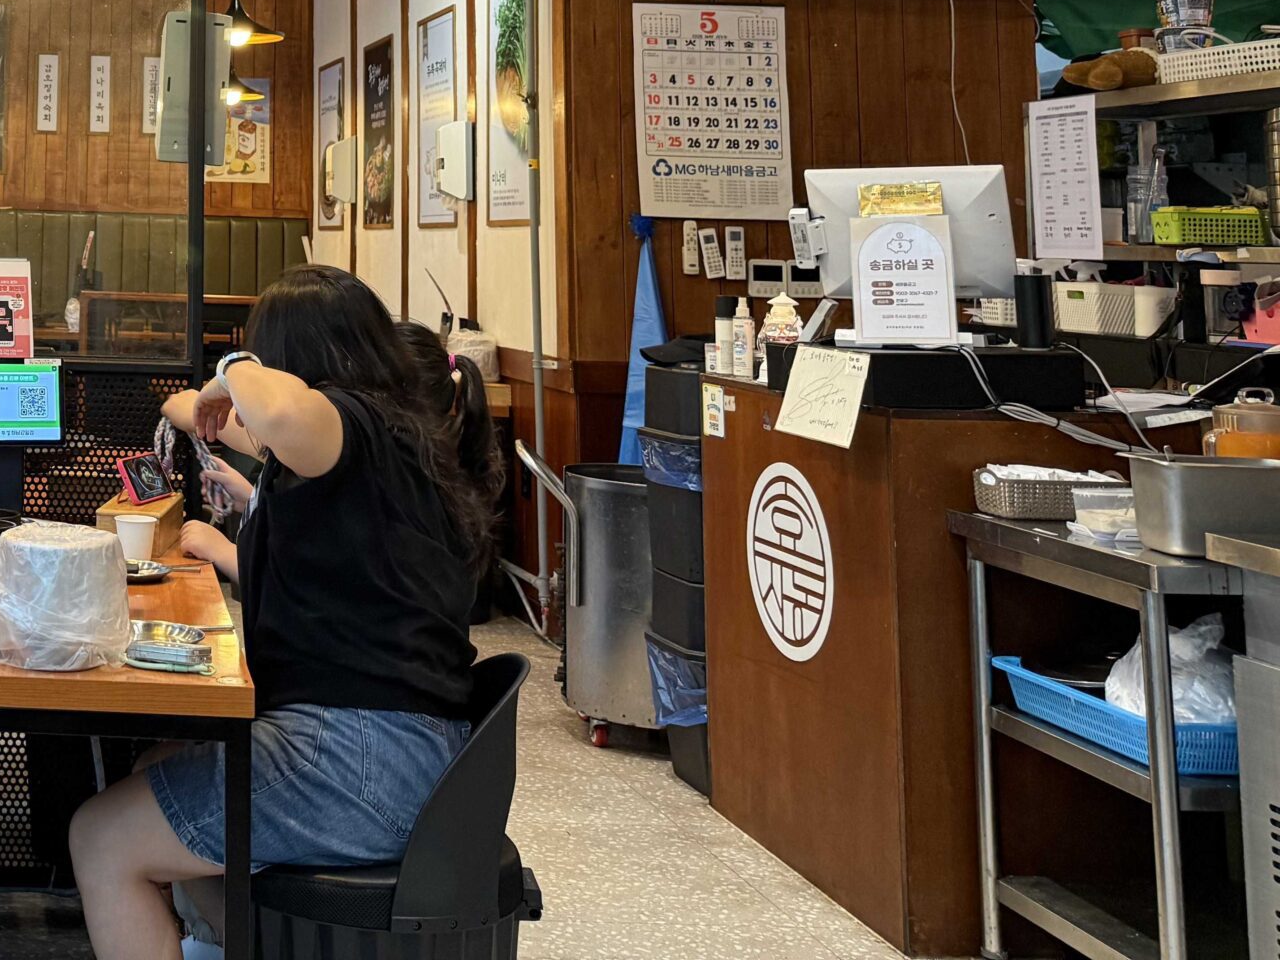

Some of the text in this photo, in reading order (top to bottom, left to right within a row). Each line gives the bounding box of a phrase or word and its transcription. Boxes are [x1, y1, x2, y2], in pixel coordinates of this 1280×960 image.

[700, 12, 719, 34] 5
[747, 56, 752, 66] 1
[765, 56, 771, 66] 2
[650, 74, 772, 87] 3 4 5 6 7 8 9
[648, 95, 776, 108] 10 11 12 13 14 15 16
[648, 116, 778, 129] 17 18 19 20 21 22 23
[669, 137, 682, 147] 25
[688, 138, 701, 148] 26
[706, 139, 719, 149] 27
[726, 140, 739, 149] 28
[745, 140, 759, 149] 29
[764, 140, 778, 149] 30
[675, 164, 778, 177] MG 하남새마을금고
[869, 258, 934, 271] 송금하실 곳
